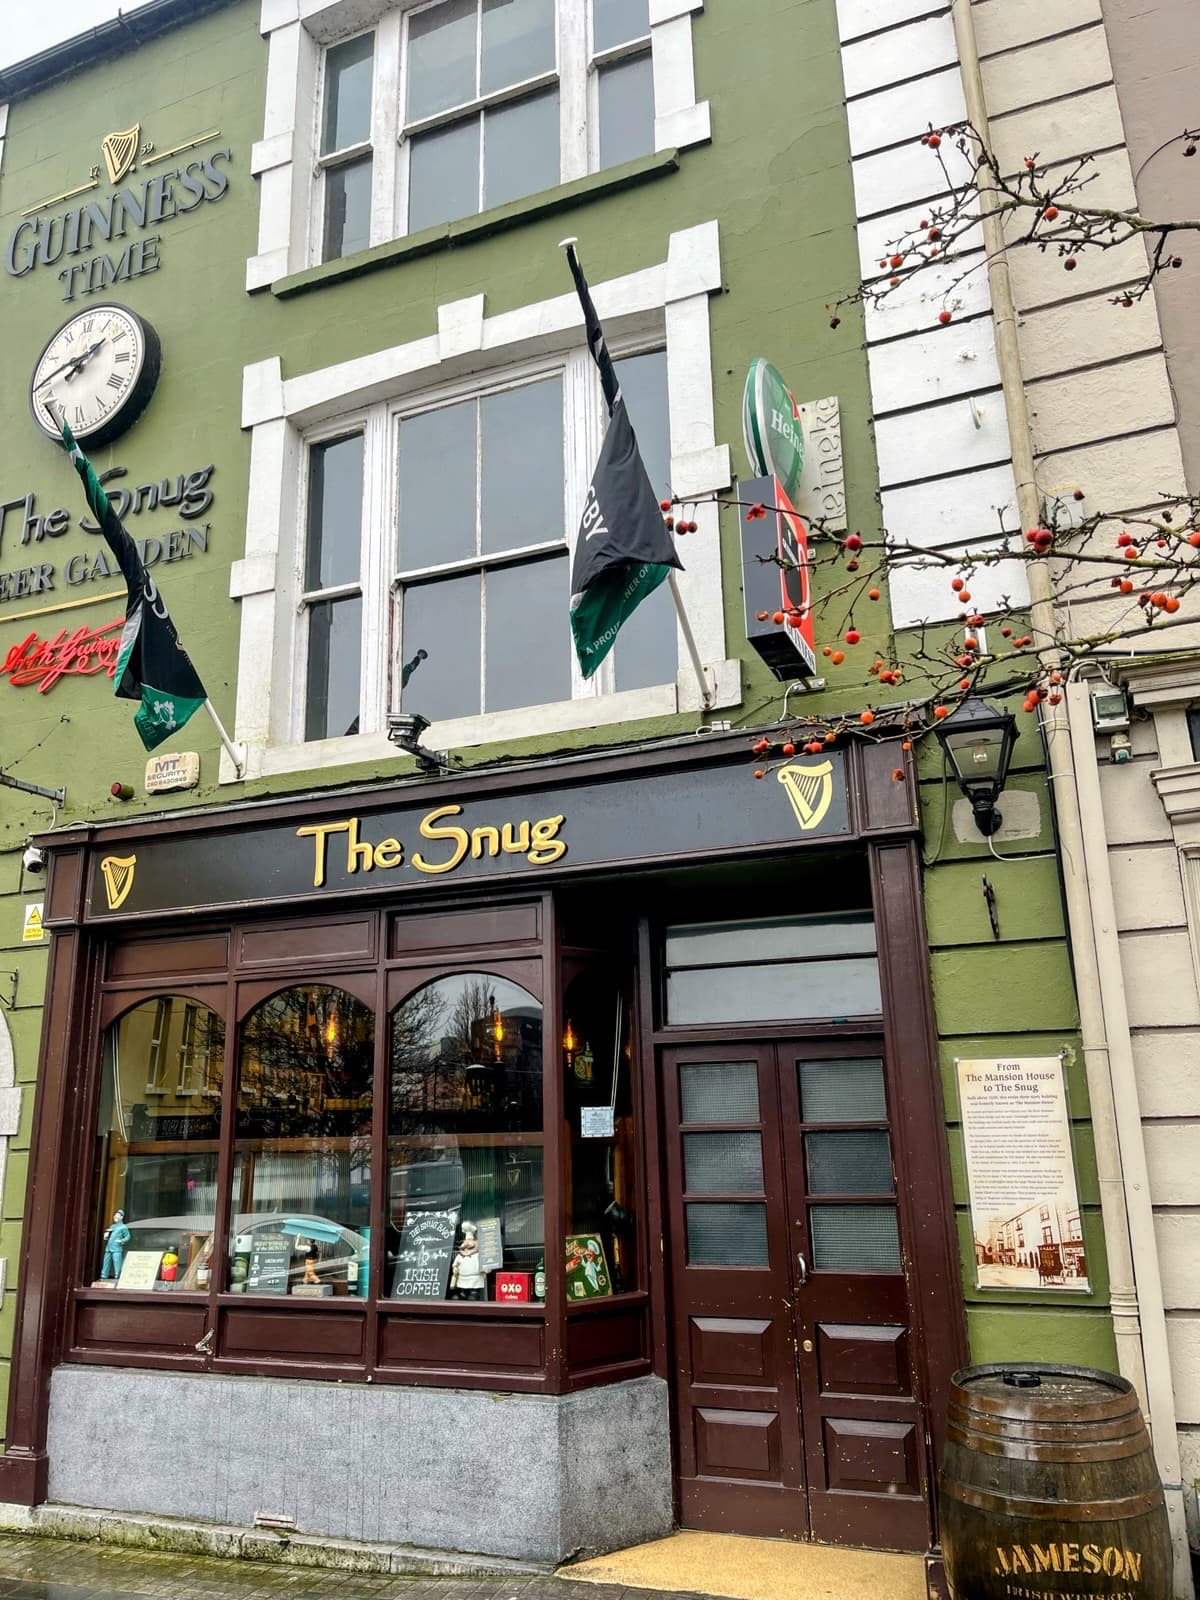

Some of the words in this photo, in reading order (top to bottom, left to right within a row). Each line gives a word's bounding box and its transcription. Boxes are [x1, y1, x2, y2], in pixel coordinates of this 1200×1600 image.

[5, 148, 231, 278] GUINNESS
[58, 235, 162, 302] TIME
[0, 492, 70, 556] The
[79, 464, 214, 535] Snug
[155, 759, 179, 773] MT
[147, 769, 187, 781] SECURITY
[296, 817, 402, 887] The
[411, 804, 567, 874] Snug
[996, 1063, 1021, 1071] From
[965, 1073, 983, 1082] The
[984, 1072, 1024, 1082] Mansion
[1026, 1071, 1056, 1081] House
[983, 1084, 993, 1092] to
[995, 1083, 1012, 1092] The
[1014, 1082, 1040, 1093] Snug
[420, 1219, 439, 1231] SNUG
[403, 1268, 440, 1281] IRISH
[396, 1282, 440, 1296] COFFEE
[995, 1543, 1142, 1582] JAMESON
